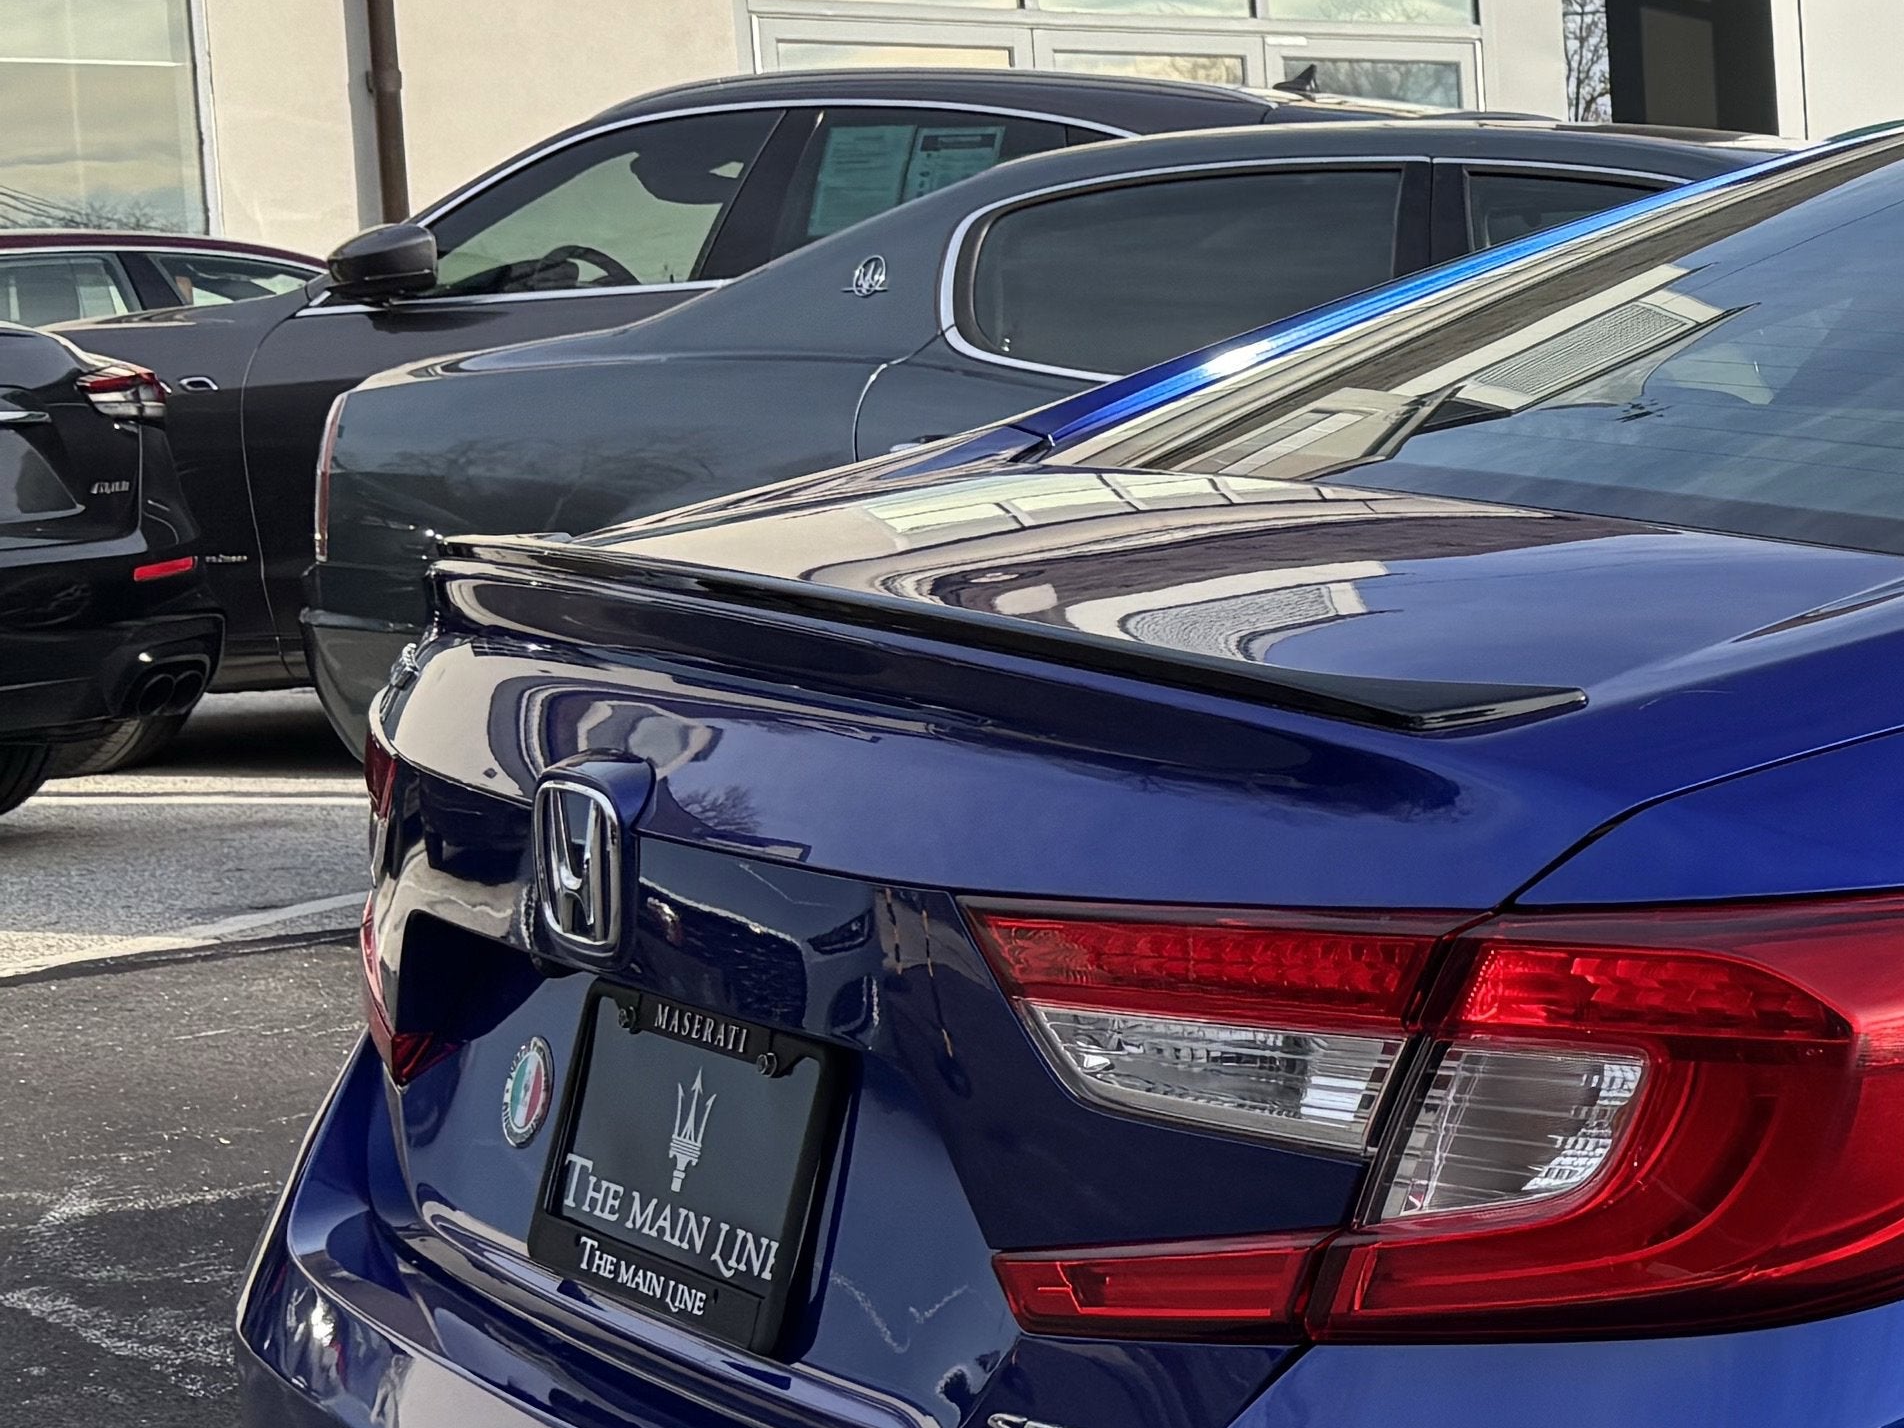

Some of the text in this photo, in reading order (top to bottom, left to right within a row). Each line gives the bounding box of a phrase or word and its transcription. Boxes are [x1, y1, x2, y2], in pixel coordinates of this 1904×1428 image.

[654, 1003, 748, 1054] MASERATI
[564, 1152, 625, 1222] THE
[625, 1189, 712, 1256] MAIN
[578, 1236, 708, 1317] THE MAIN LINE
